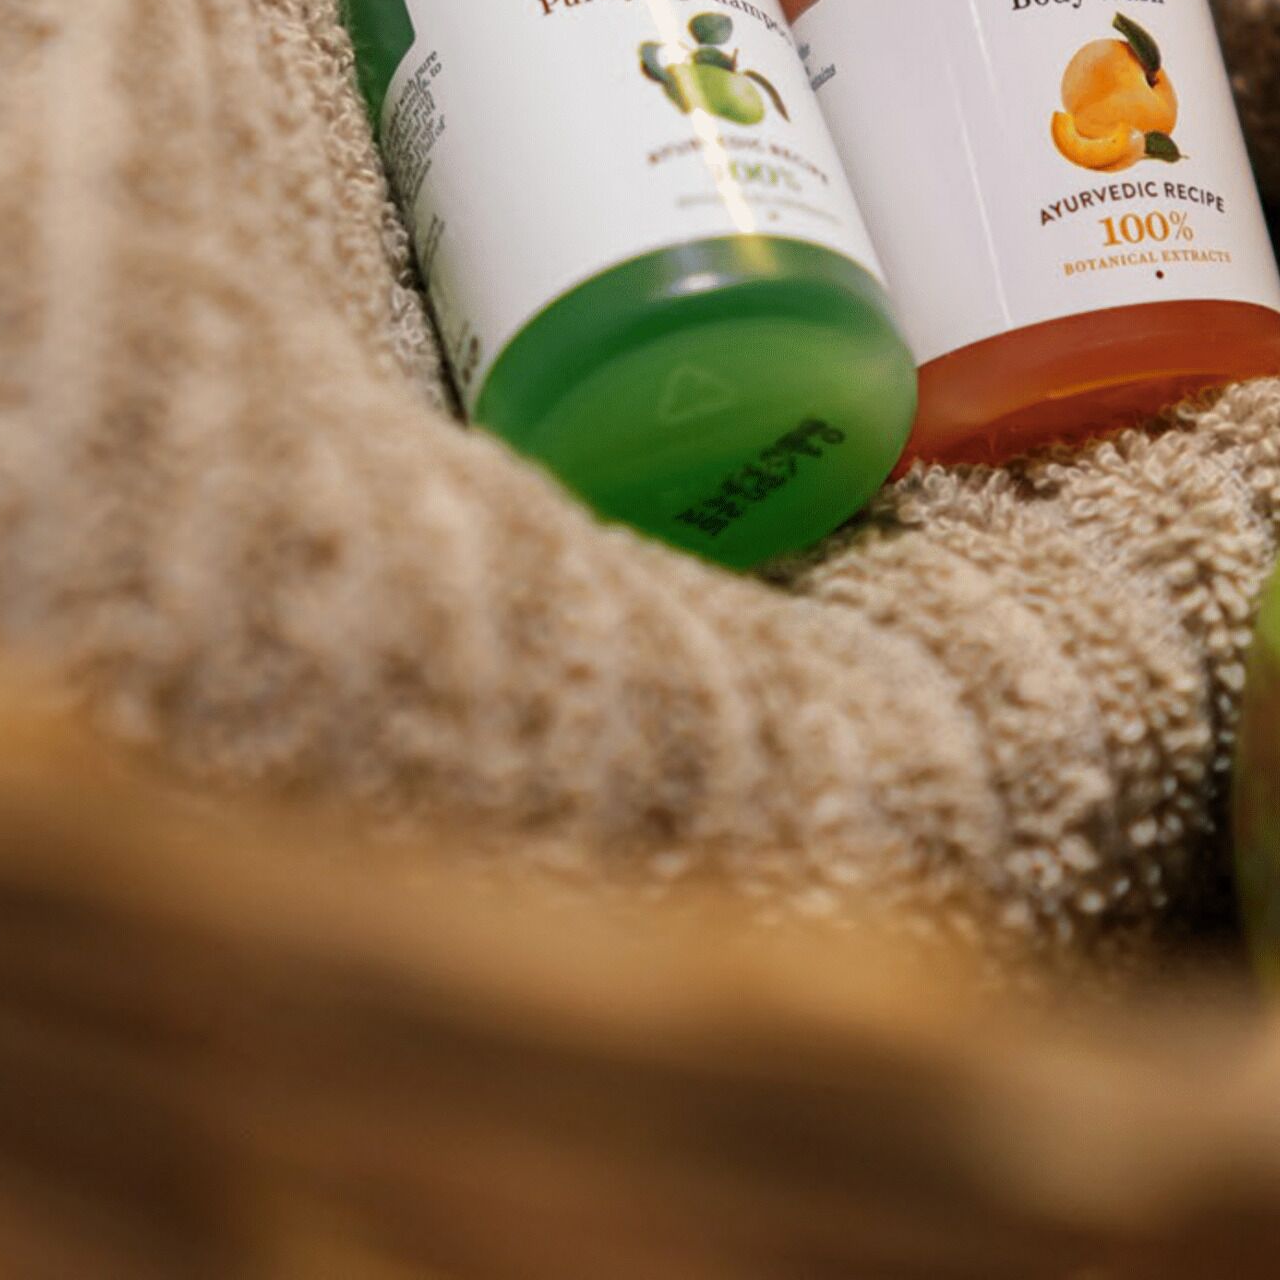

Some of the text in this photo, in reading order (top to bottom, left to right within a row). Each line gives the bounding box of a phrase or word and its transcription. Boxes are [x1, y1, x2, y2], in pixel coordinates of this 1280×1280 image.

[1040, 181, 1225, 227] AYURVEDIC RECIPE
[1098, 210, 1194, 247] 100%
[1064, 248, 1232, 277] BOTANICAL EXTRACTS
